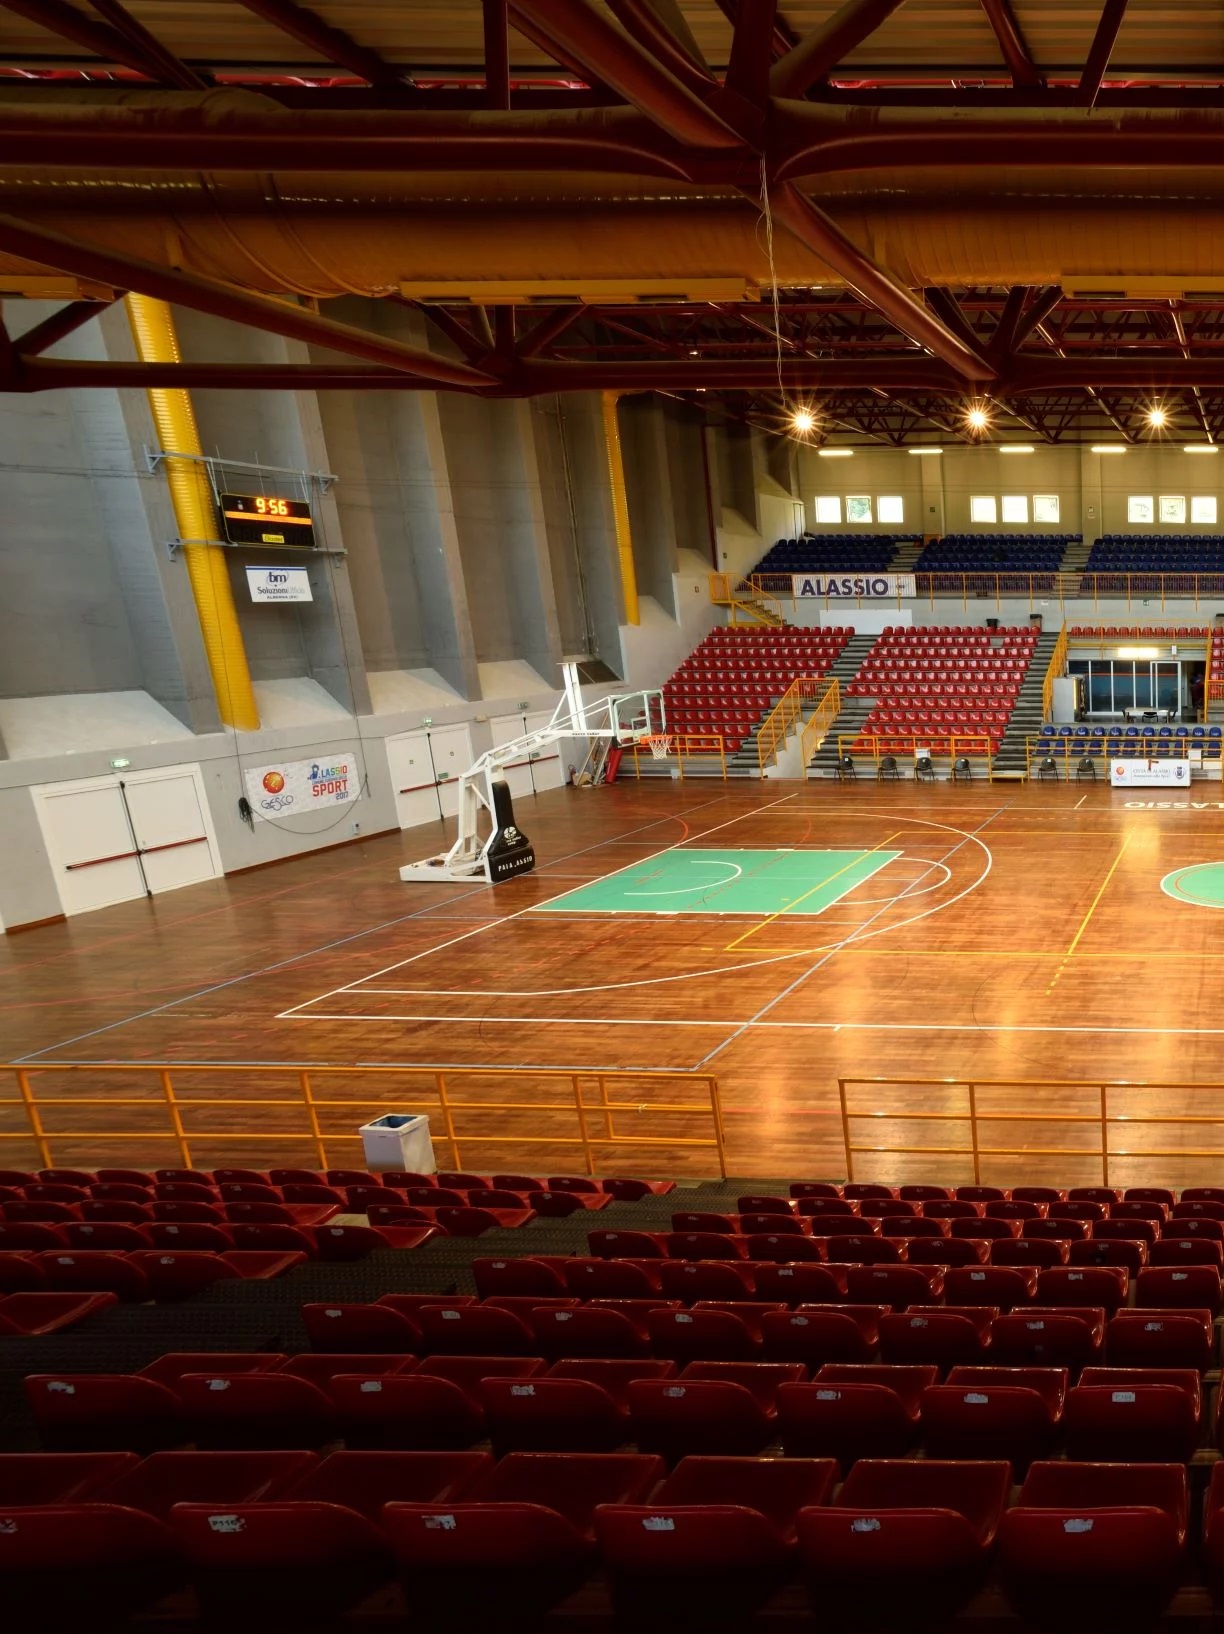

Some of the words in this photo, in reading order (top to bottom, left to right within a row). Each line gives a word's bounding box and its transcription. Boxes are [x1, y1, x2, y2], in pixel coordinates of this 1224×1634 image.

[256, 498, 288, 515] 9:56
[269, 572, 287, 583] bm
[800, 578, 888, 596] ALASSIO
[312, 779, 348, 797] SPORT
[260, 795, 294, 811] GESCO
